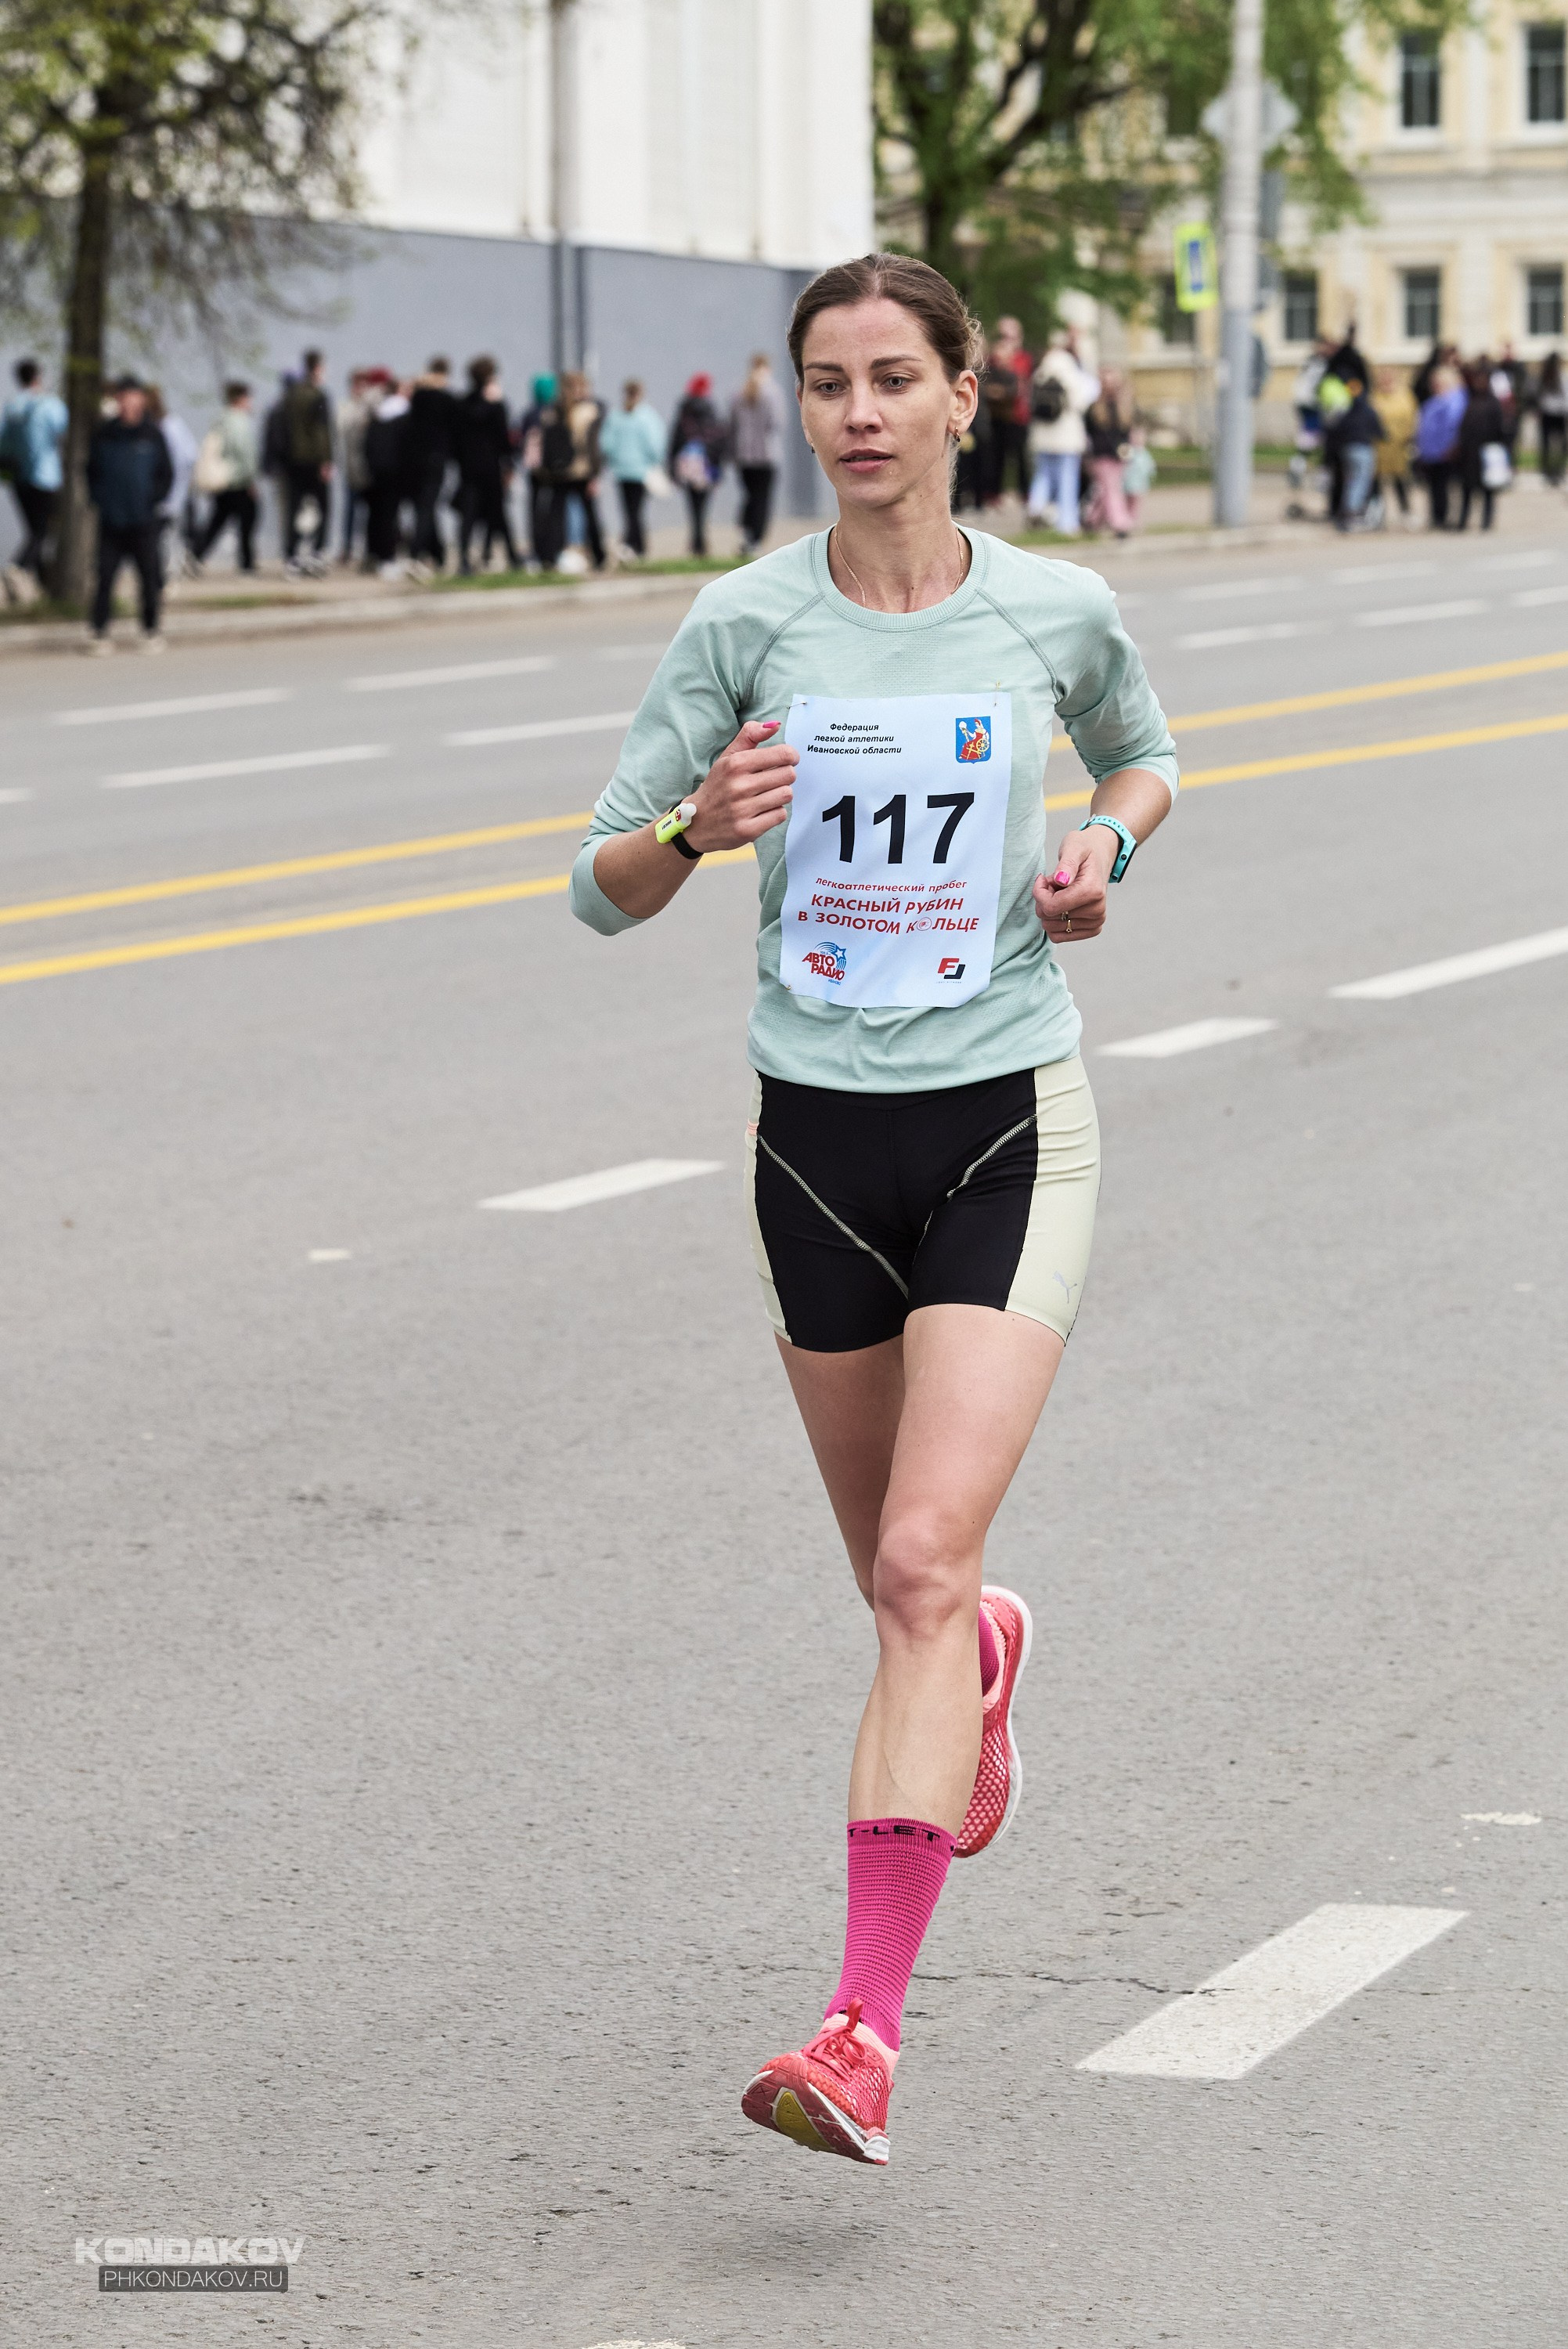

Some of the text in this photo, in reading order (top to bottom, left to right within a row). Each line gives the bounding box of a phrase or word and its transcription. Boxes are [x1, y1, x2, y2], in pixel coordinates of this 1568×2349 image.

[830, 723, 879, 732] Федерация
[807, 745, 860, 754] Ивановской
[822, 792, 975, 864] 117
[816, 878, 968, 893] легкоатлетический пробег
[811, 893, 964, 914] КРАСНЫЙ РУБИН
[798, 911, 808, 921] В
[815, 912, 900, 934] ЗОЛОТОМ
[802, 952, 835, 967] АВТО
[810, 962, 845, 980] РАДИО
